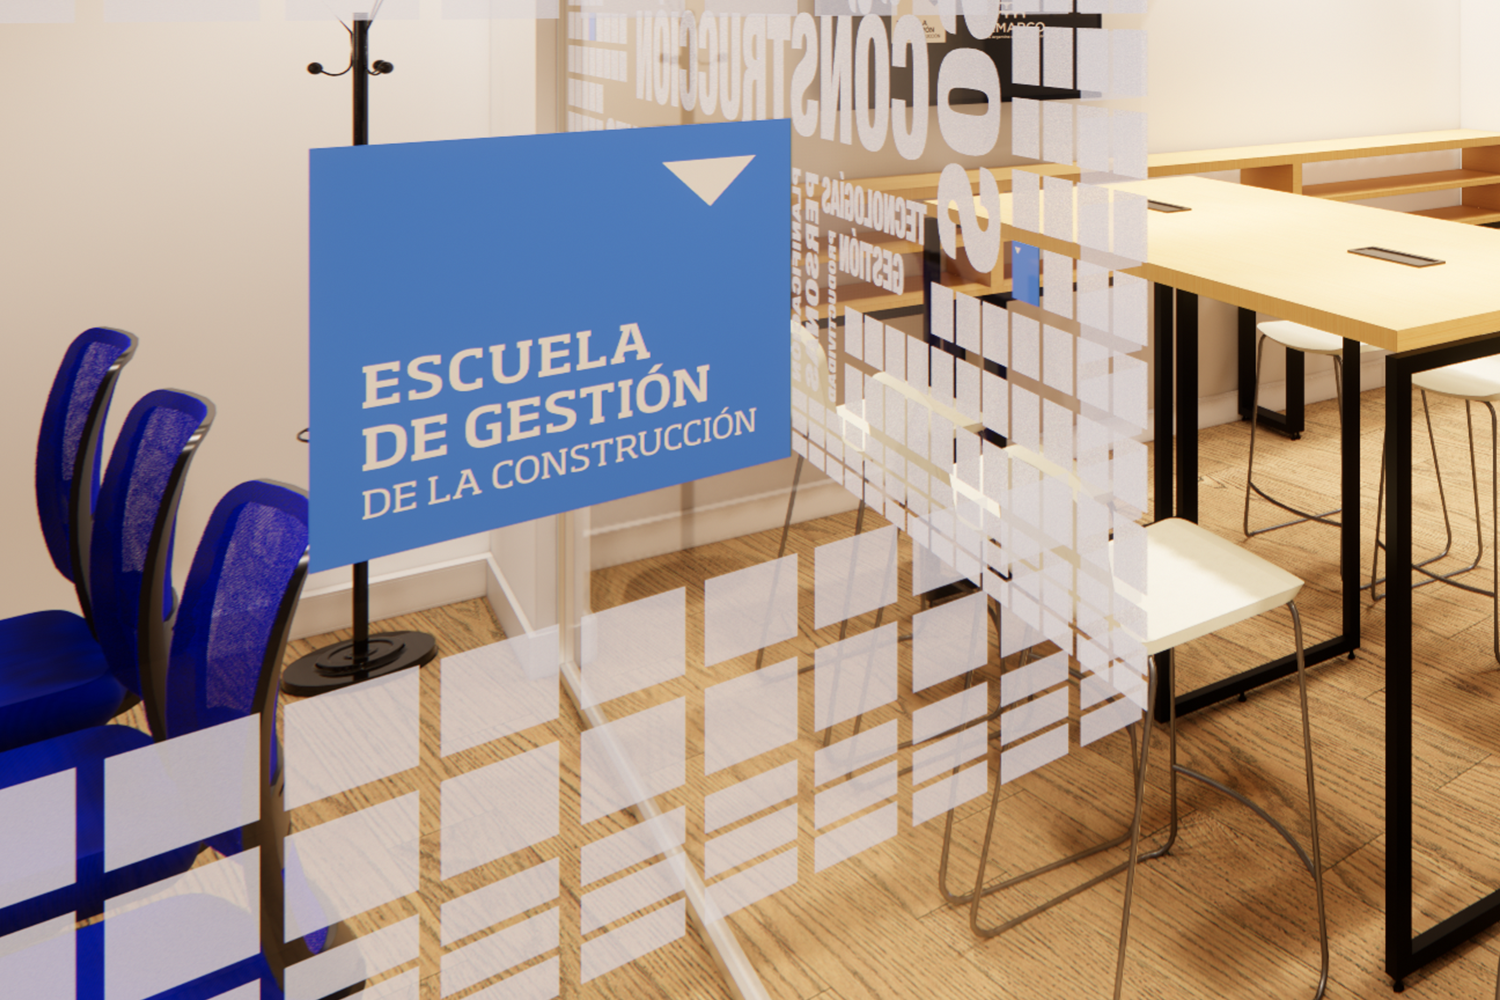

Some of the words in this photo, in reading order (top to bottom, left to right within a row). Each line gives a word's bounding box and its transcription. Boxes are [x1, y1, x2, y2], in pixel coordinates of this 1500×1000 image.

[361, 322, 651, 409] ESCUELA
[361, 413, 448, 472] DE
[464, 363, 710, 450] GESTIÓN
[361, 481, 417, 521] DE
[427, 469, 482, 505] LA
[491, 407, 758, 490] CONSTRUCCIÓN
